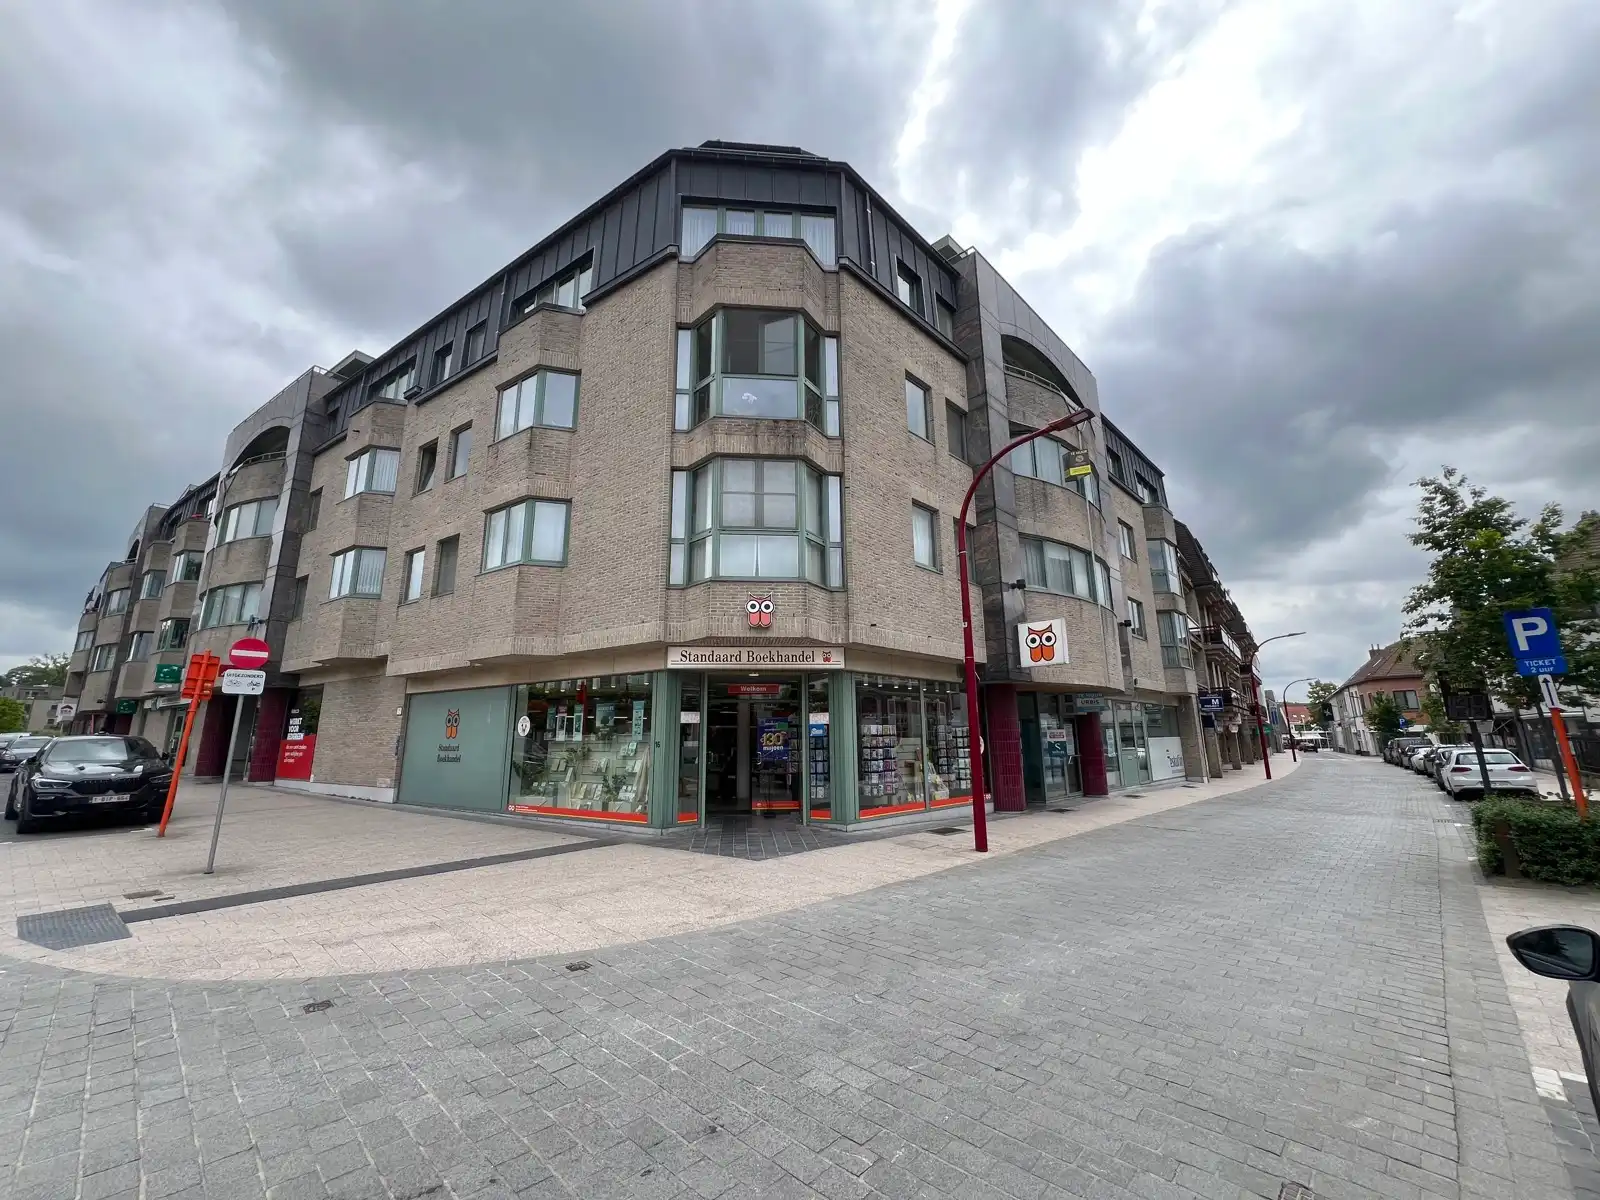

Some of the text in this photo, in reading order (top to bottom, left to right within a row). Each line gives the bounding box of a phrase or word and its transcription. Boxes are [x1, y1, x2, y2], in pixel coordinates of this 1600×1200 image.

[1512, 617, 1548, 651] P
[680, 650, 815, 662] Standaard Boekhandel
[1524, 659, 1556, 667] TICKET
[438, 743, 460, 752] Standaard
[436, 753, 462, 763] Boekhandel
